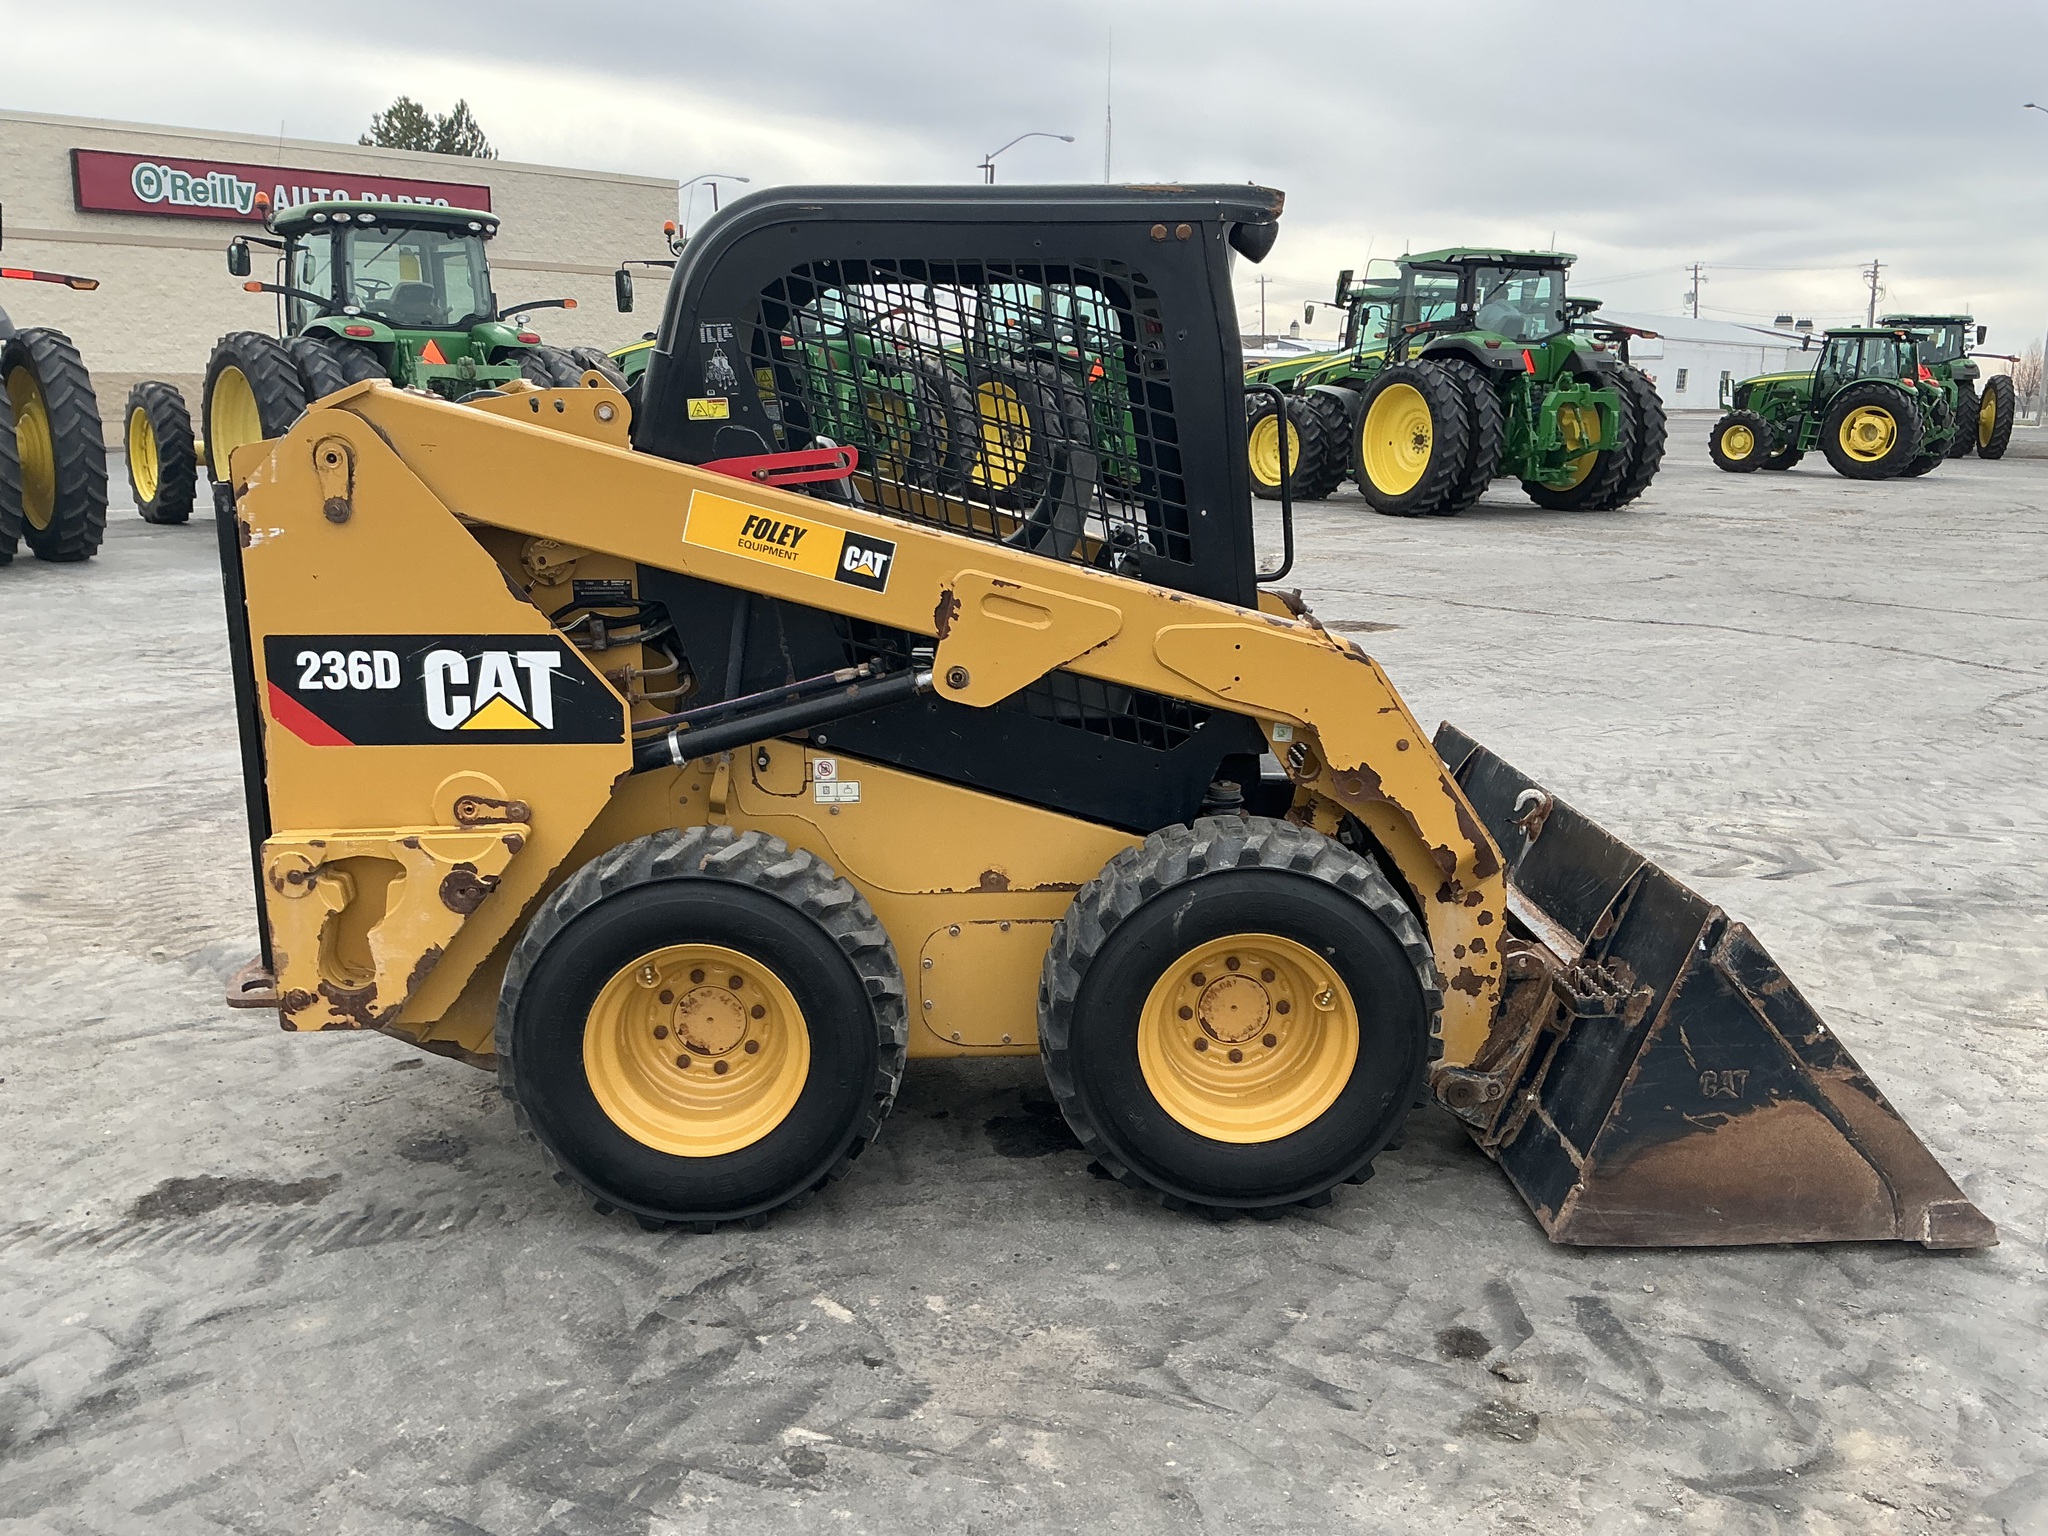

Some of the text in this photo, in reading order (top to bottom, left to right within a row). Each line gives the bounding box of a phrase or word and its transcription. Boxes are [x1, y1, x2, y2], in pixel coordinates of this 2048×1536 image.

[133, 163, 256, 213] O'Reilly
[741, 514, 808, 549] FOLEY
[737, 538, 799, 561] EQUIPMENT
[843, 546, 888, 578] CAT
[296, 651, 401, 690] 236D
[423, 649, 561, 730] CAT
[1699, 1069, 1751, 1099] CAT
